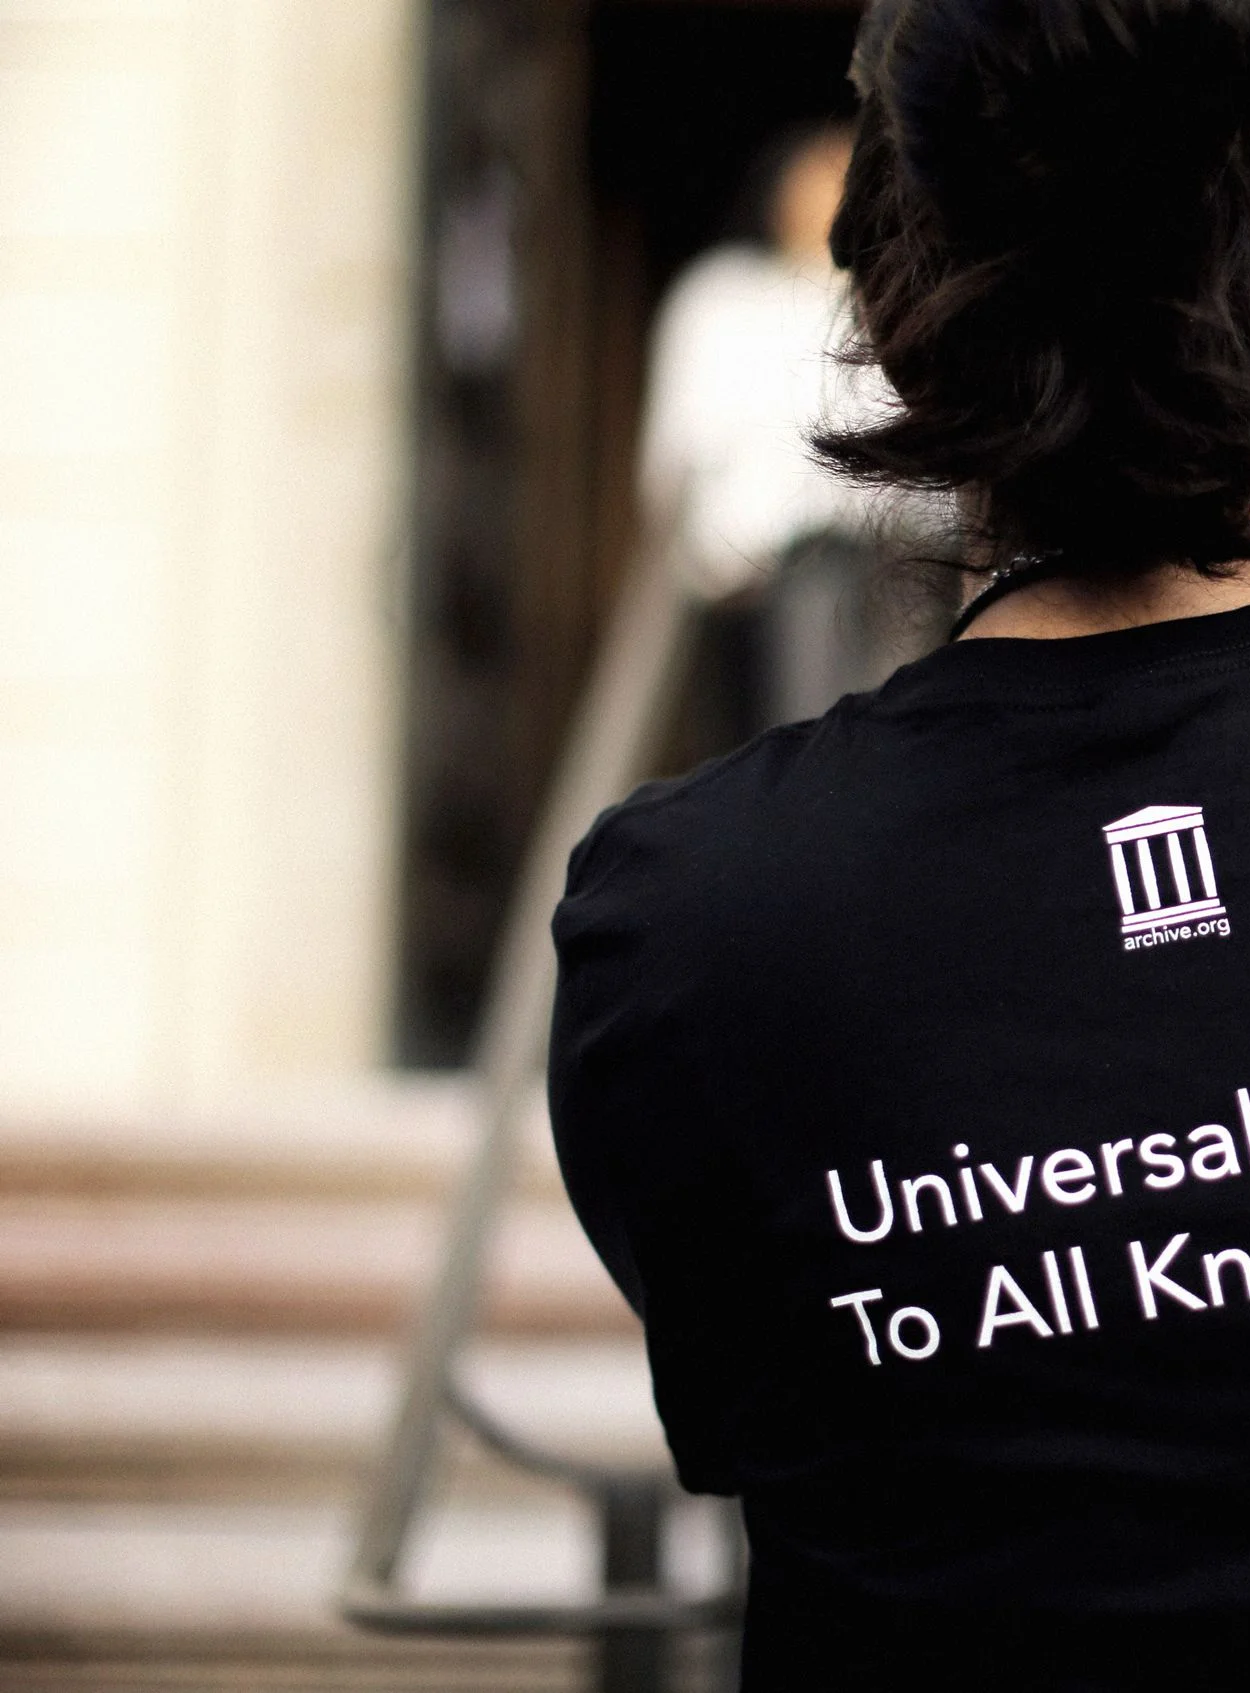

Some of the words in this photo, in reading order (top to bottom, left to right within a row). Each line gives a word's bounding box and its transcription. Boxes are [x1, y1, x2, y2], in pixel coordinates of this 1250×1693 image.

[1123, 917, 1231, 951] archive.org
[830, 1289, 941, 1366] To
[977, 1245, 1100, 1348] All
